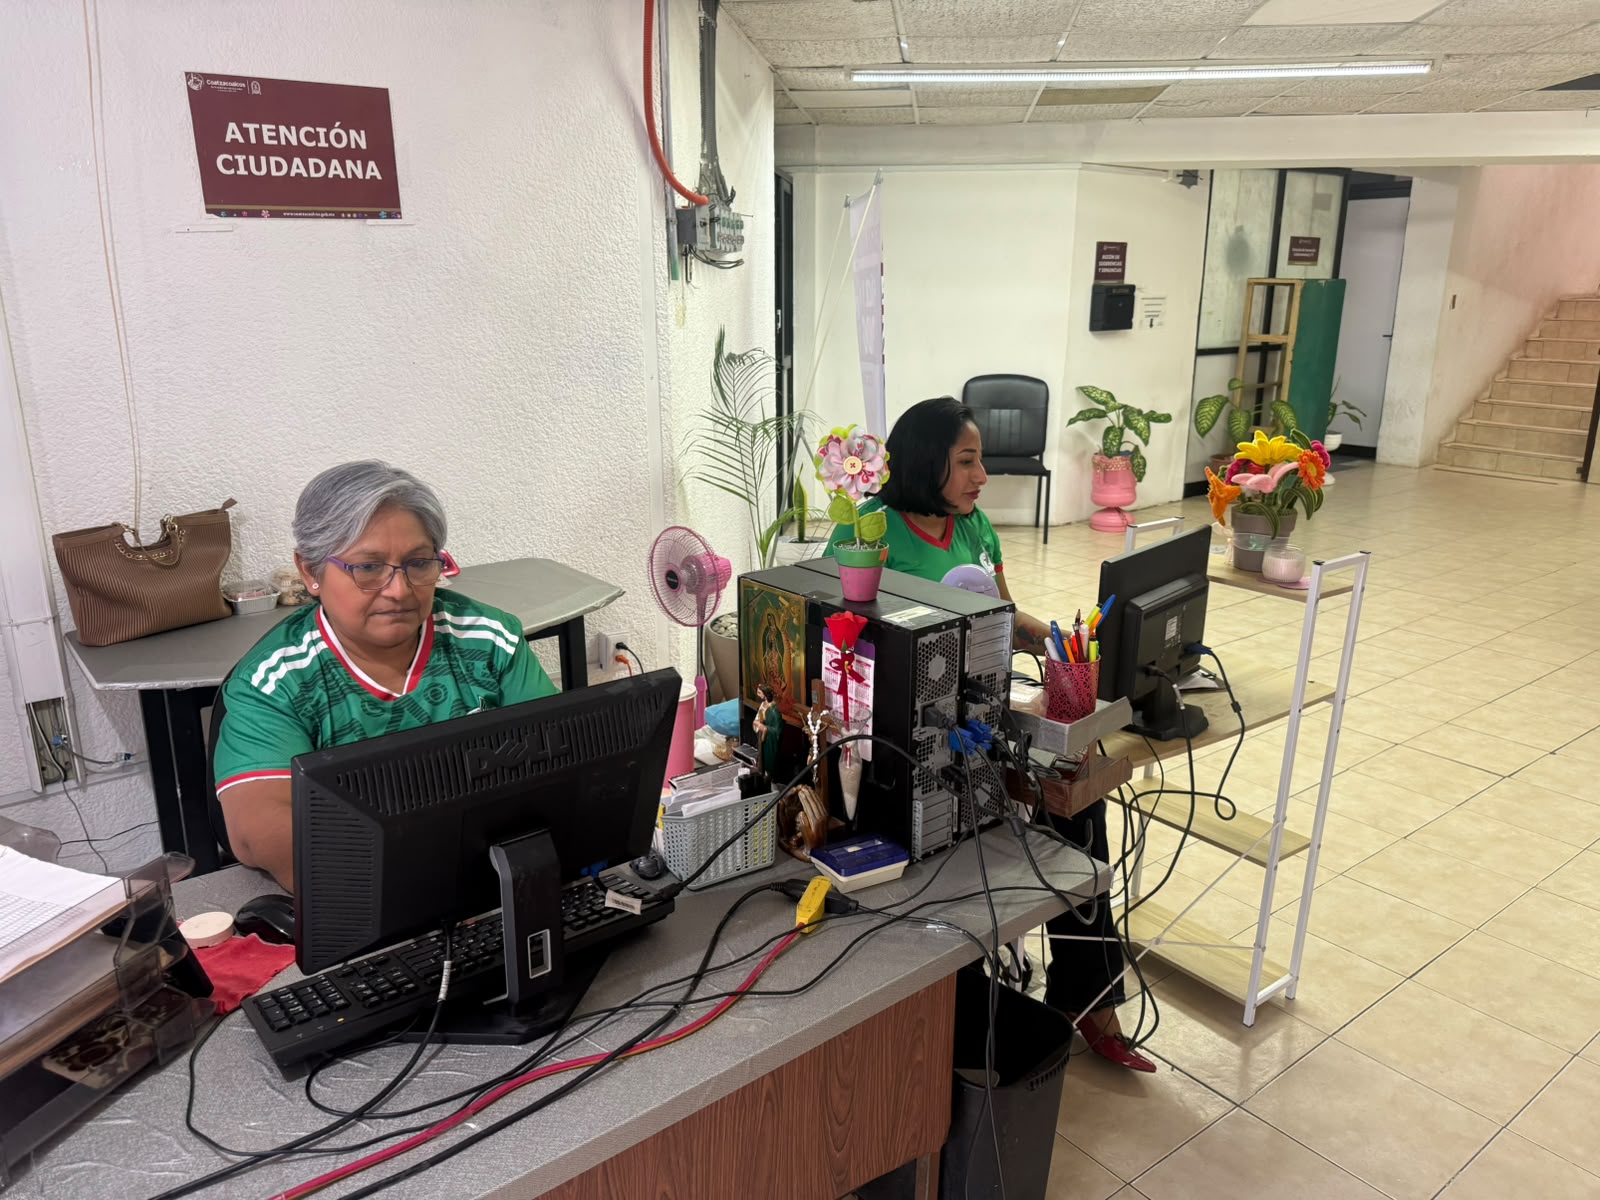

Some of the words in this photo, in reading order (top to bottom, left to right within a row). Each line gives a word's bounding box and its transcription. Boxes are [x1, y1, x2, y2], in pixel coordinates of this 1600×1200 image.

[224, 121, 367, 150] ATENCIÓN
[216, 153, 382, 180] CIUDADANA
[465, 728, 570, 780] DELL
